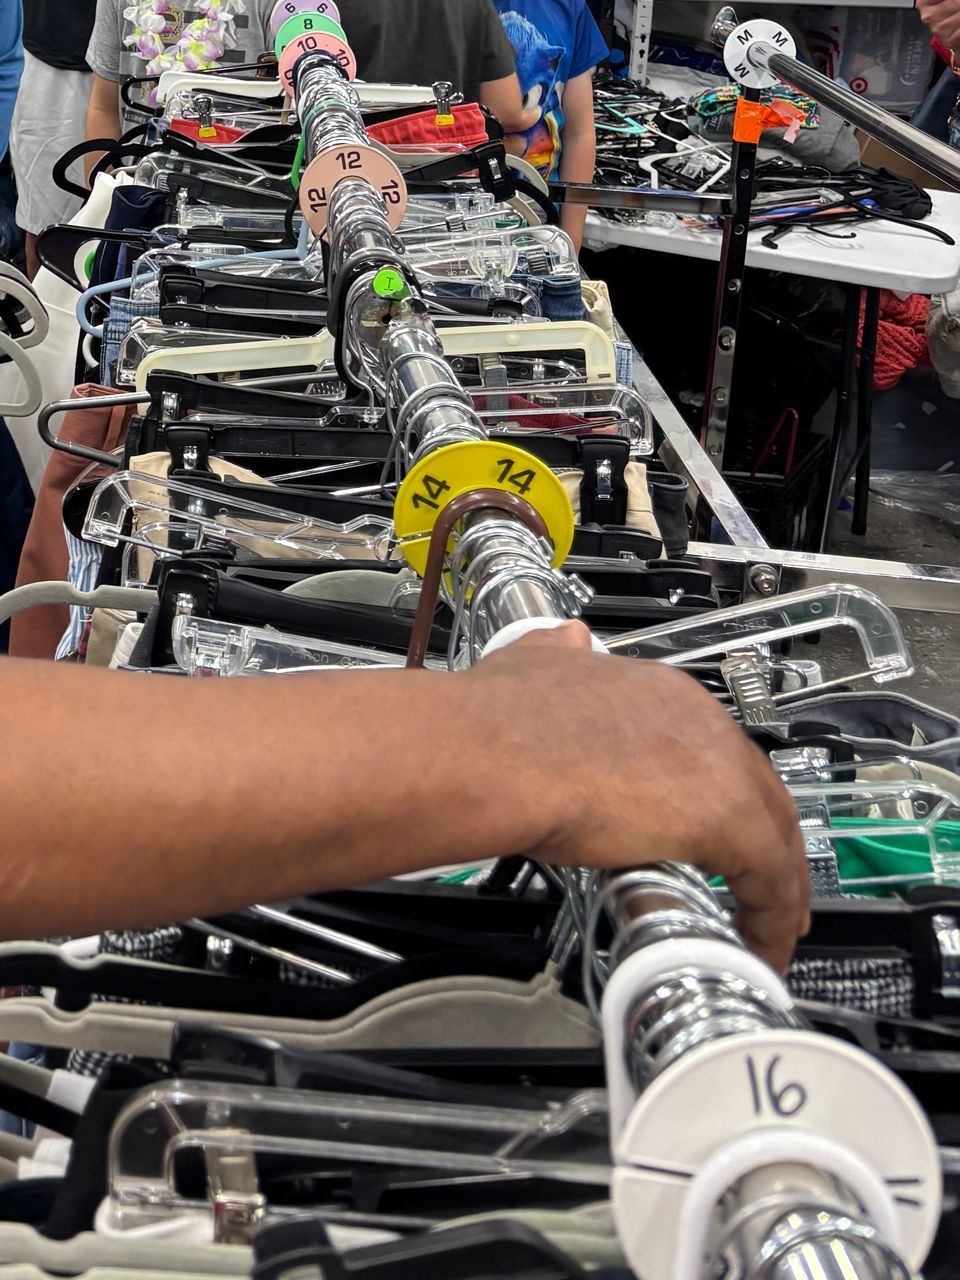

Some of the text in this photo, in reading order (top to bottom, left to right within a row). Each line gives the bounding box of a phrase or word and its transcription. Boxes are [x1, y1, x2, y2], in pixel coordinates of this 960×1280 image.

[285, 3, 296, 13] 6
[317, 3, 328, 13] 6
[304, 19, 313, 30] 8
[297, 36, 317, 52] 10
[737, 29, 753, 45] M
[772, 31, 788, 47] M
[336, 48, 350, 68] 10
[336, 151, 362, 170] 12
[308, 187, 327, 213] 12
[381, 180, 400, 204] 12
[496, 458, 536, 495] 14
[411, 474, 450, 510] 14
[745, 1053, 807, 1118] 16
